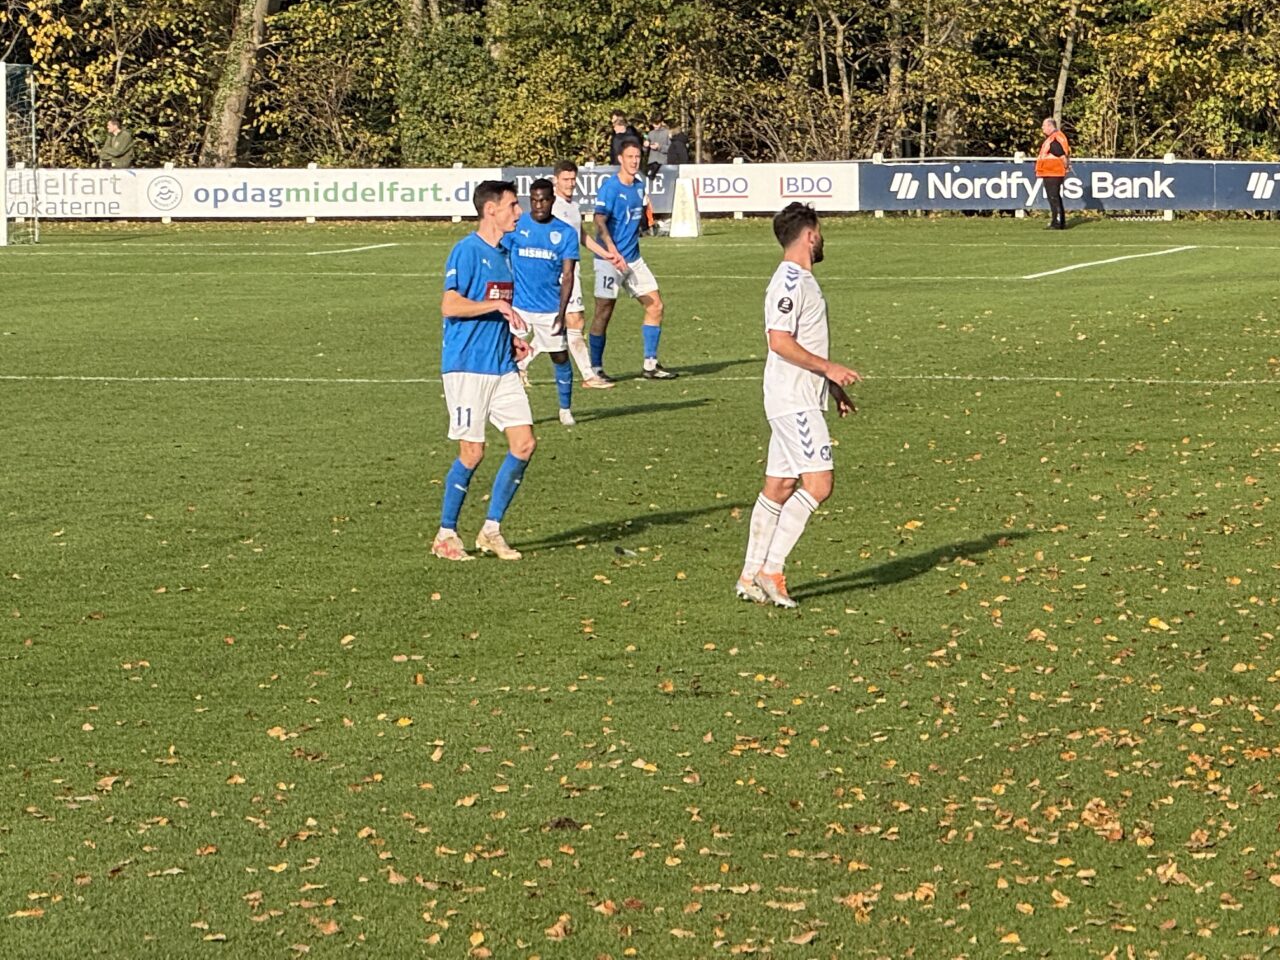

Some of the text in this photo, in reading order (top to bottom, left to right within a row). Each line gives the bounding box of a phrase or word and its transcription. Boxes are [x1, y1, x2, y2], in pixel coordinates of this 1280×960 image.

[8, 172, 122, 195] ddelfart
[702, 177, 749, 193] BDO
[786, 176, 833, 193] BDO
[1091, 170, 1175, 200] Bank
[194, 181, 478, 208] opdagmiddelfart.d
[6, 197, 120, 215] vokaterne
[602, 276, 615, 289] 12
[456, 406, 472, 428] 11
